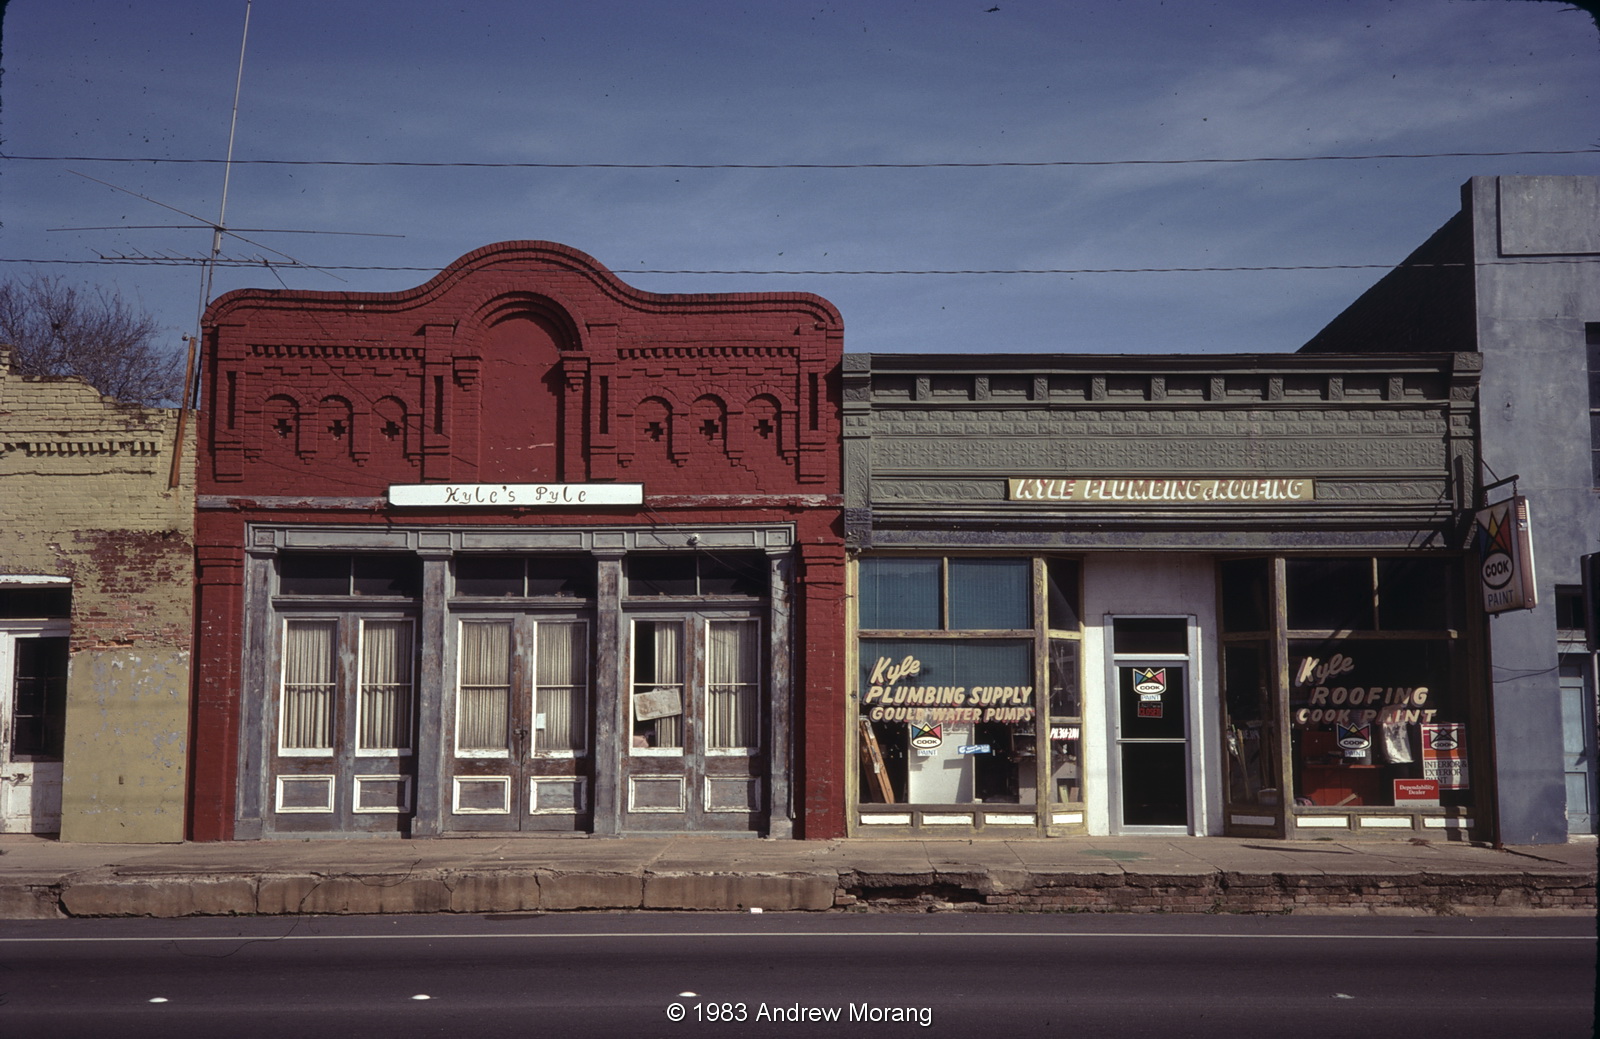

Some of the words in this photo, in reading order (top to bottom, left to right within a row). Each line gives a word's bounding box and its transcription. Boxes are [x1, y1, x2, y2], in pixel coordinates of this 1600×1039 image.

[444, 485, 516, 505] Kyle's
[535, 485, 588, 505] Pyle
[1015, 478, 1076, 500] KYLE
[1083, 478, 1202, 500] PLUMBING
[1213, 478, 1303, 500] ROOFING
[1485, 560, 1510, 578] COOK
[1487, 590, 1514, 608] PAINT
[869, 655, 921, 685] Kyle
[1296, 653, 1355, 685] Kyle
[865, 686, 966, 706] PLUMBING
[969, 686, 1033, 706] SUPPLY
[1310, 686, 1429, 706] ROOFING
[870, 707, 927, 723] GOULD
[932, 708, 982, 723] WATER
[985, 708, 1034, 723] PUMPS
[1296, 708, 1351, 724] COOK
[1360, 708, 1438, 724] PAINT
[1424, 760, 1461, 768] INTERIOR
[1424, 768, 1463, 776] EXTERIOR
